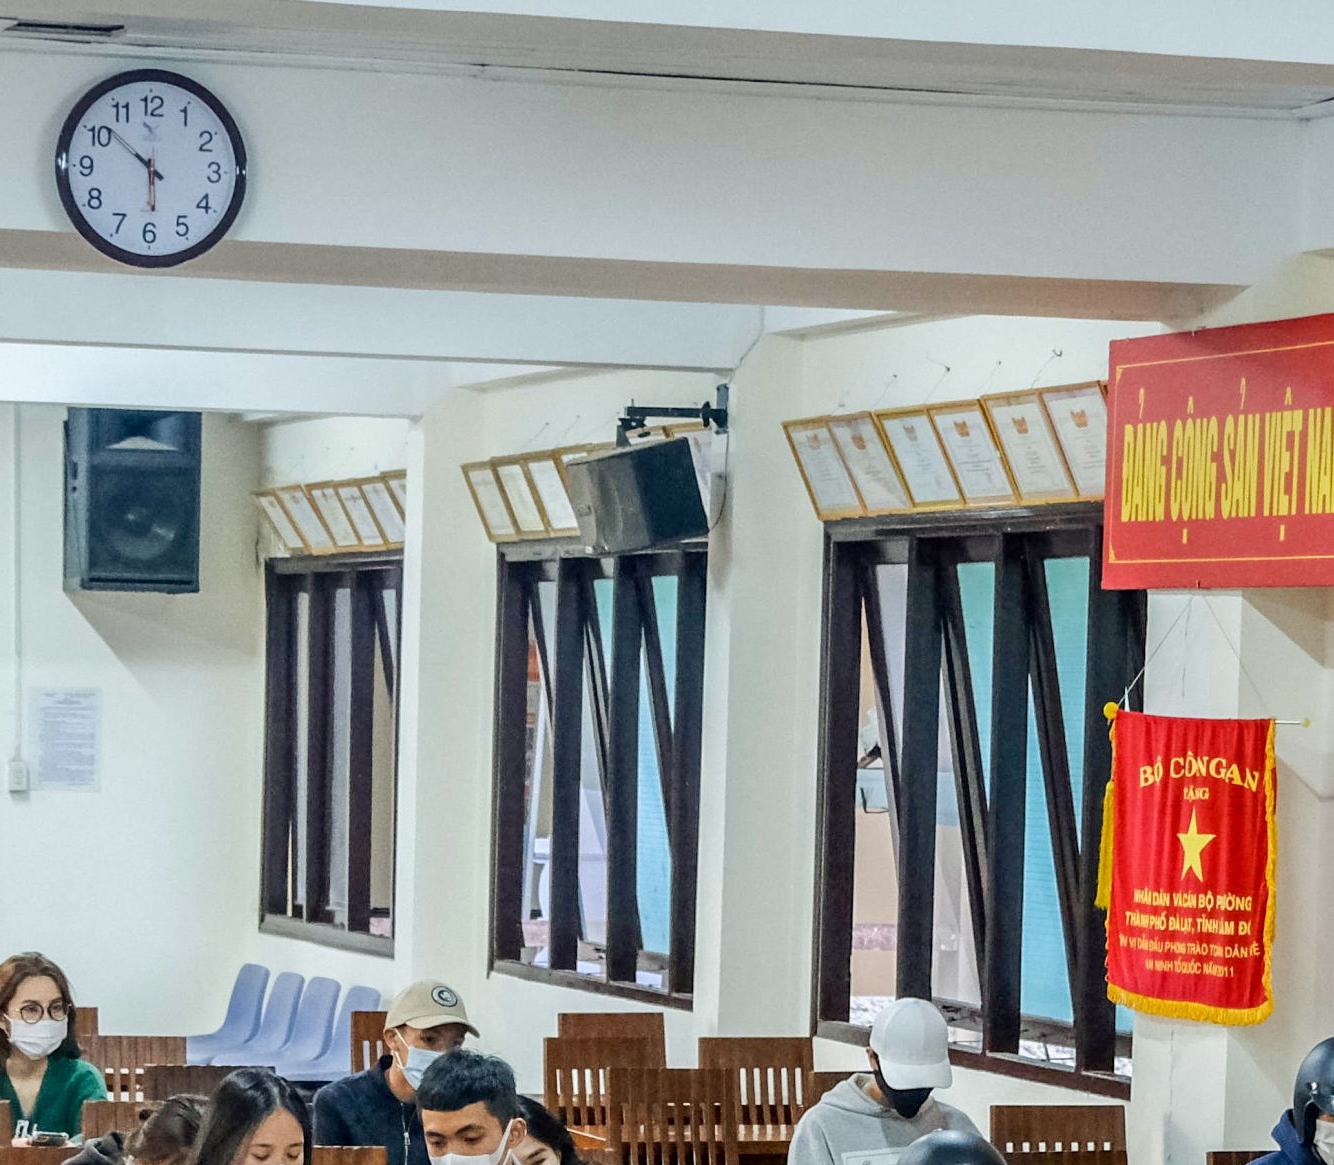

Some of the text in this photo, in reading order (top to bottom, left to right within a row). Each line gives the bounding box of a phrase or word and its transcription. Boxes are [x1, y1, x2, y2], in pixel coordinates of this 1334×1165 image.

[112, 101, 130, 123] 11
[140, 95, 164, 118] 12
[179, 106, 188, 127] 1
[88, 125, 112, 147] 10
[199, 130, 213, 152] 2
[79, 155, 94, 177] 9
[207, 161, 222, 184] 3
[87, 187, 102, 210] 8
[196, 193, 212, 215] 4
[112, 213, 127, 235] 7
[142, 222, 157, 244] 6
[175, 215, 190, 237] 5
[1121, 387, 1167, 522] ĐẢNG
[1170, 396, 1218, 544] CỘNG
[1221, 377, 1260, 518] SẢN
[1263, 386, 1303, 541] VIỆT
[1139, 755, 1163, 787] BỘ
[1224, 763, 1259, 793] AN
[1198, 890, 1214, 912] BỘ
[1149, 911, 1167, 932] PHỐ
[1196, 913, 1219, 934] TỈNH
[1224, 944, 1248, 958] DÂN
